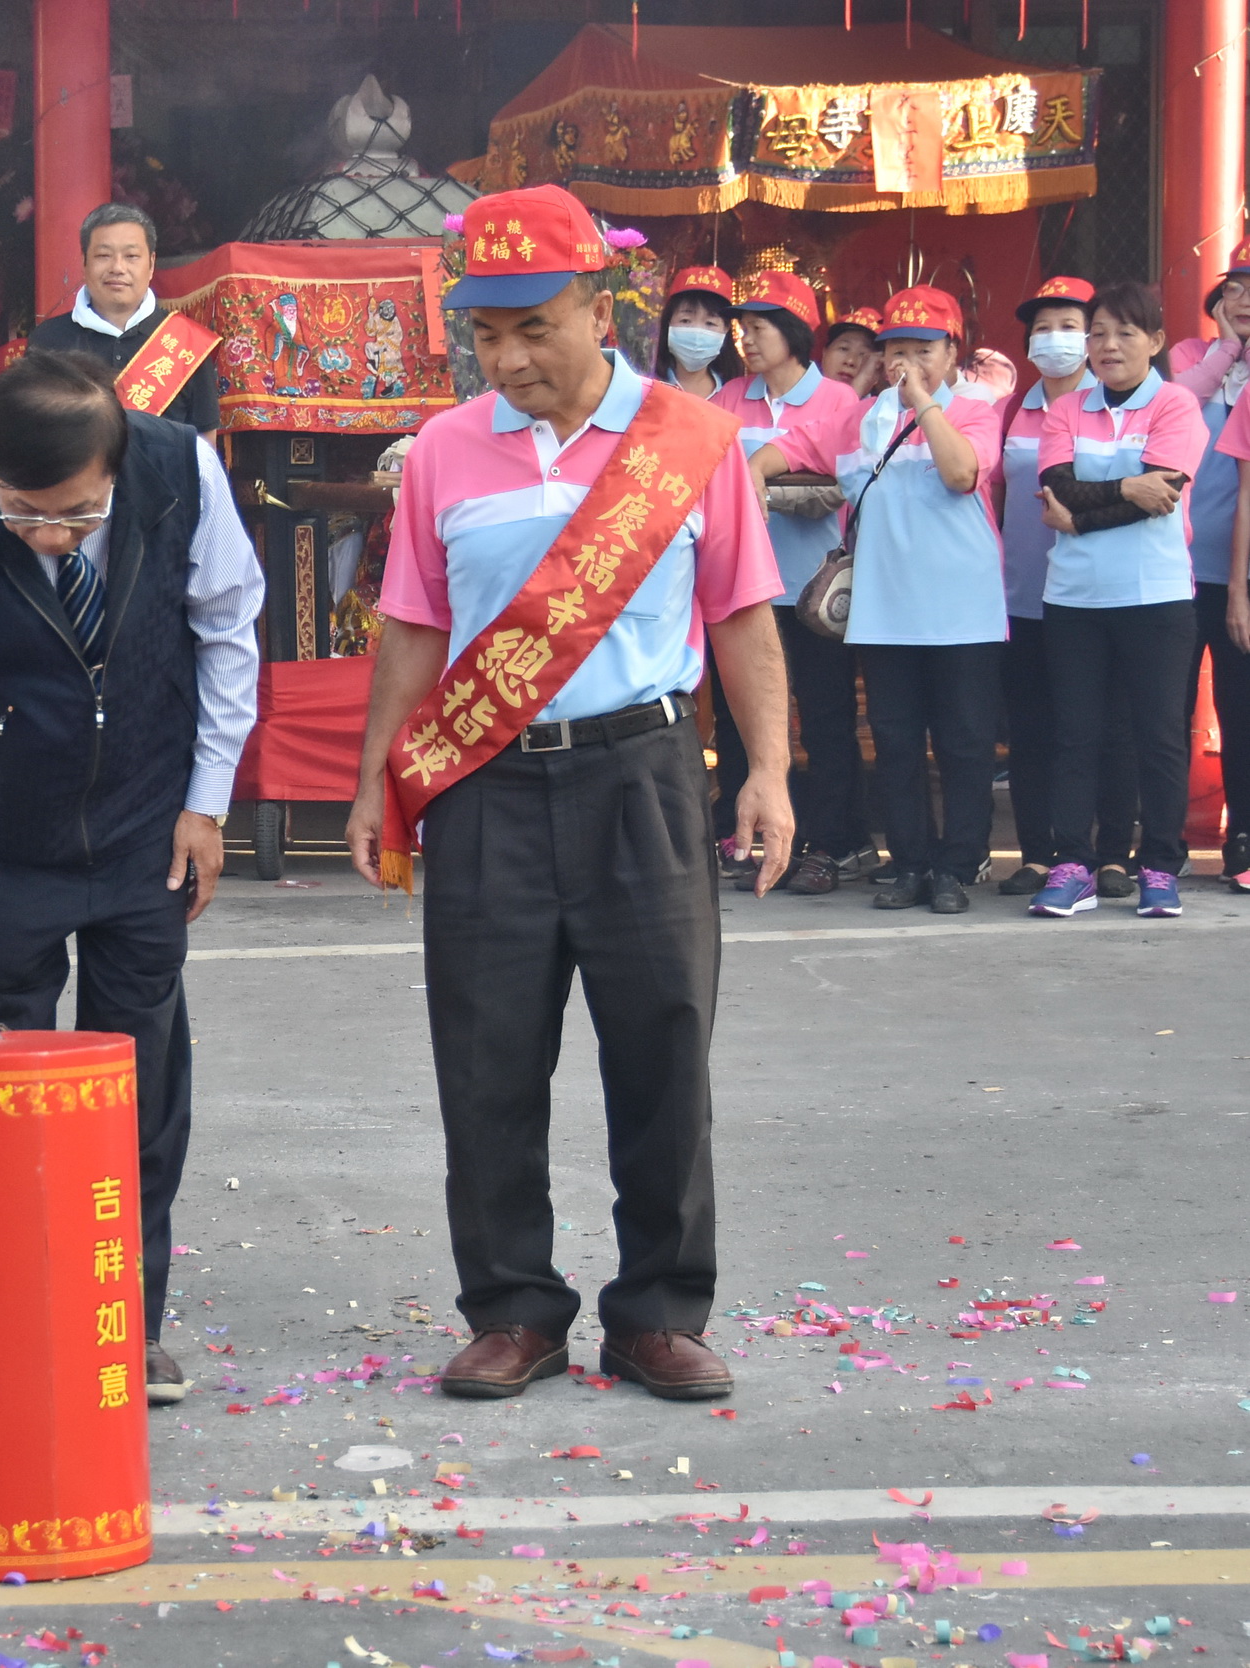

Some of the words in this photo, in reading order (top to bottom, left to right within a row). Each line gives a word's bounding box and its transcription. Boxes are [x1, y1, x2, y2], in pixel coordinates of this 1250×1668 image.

[472, 235, 537, 262] 慶福寺
[126, 355, 175, 411] 慶福
[91, 1175, 130, 1410] 吉祥如意
